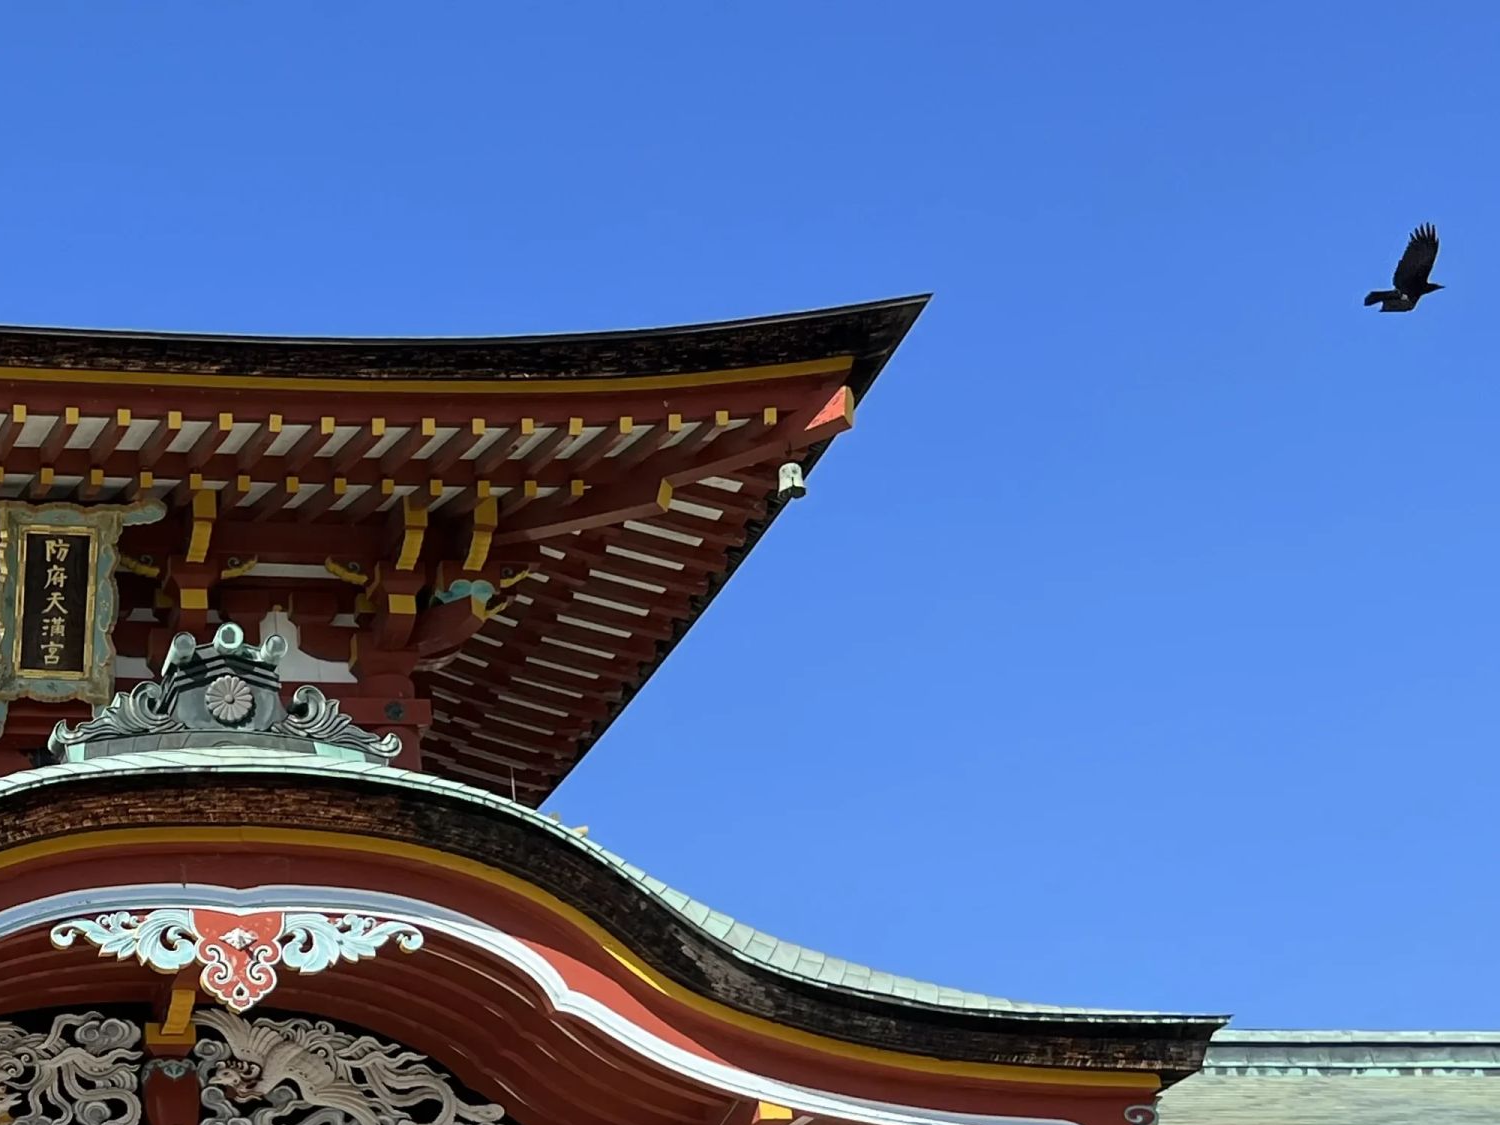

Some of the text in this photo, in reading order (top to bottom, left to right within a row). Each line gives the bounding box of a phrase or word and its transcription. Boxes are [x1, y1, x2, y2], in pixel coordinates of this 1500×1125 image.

[40, 538, 70, 665] 防府天満宮
